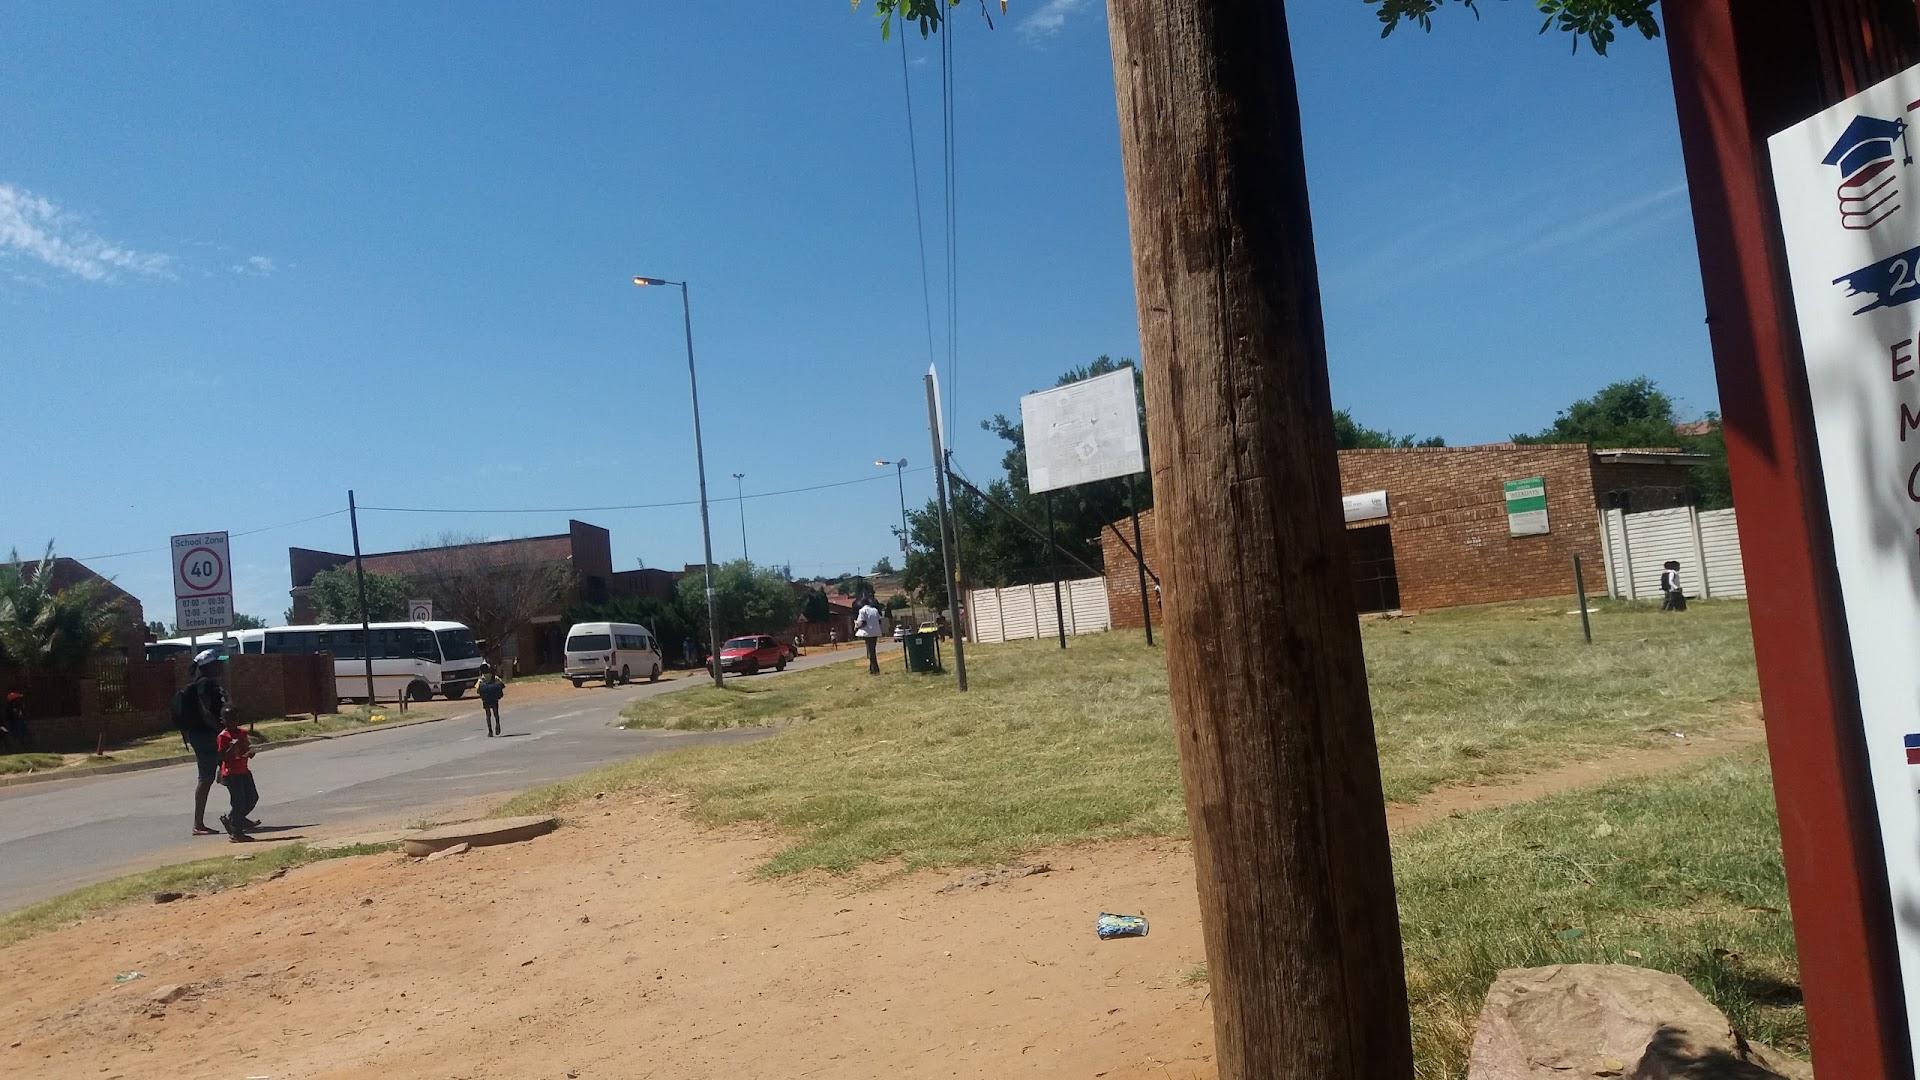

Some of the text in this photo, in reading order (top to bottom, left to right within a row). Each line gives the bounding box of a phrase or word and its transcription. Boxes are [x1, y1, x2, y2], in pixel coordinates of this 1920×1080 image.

[175, 536, 224, 548] School Zone
[190, 560, 213, 577] 40
[416, 612, 426, 620] 40
[185, 617, 225, 627] School Days
